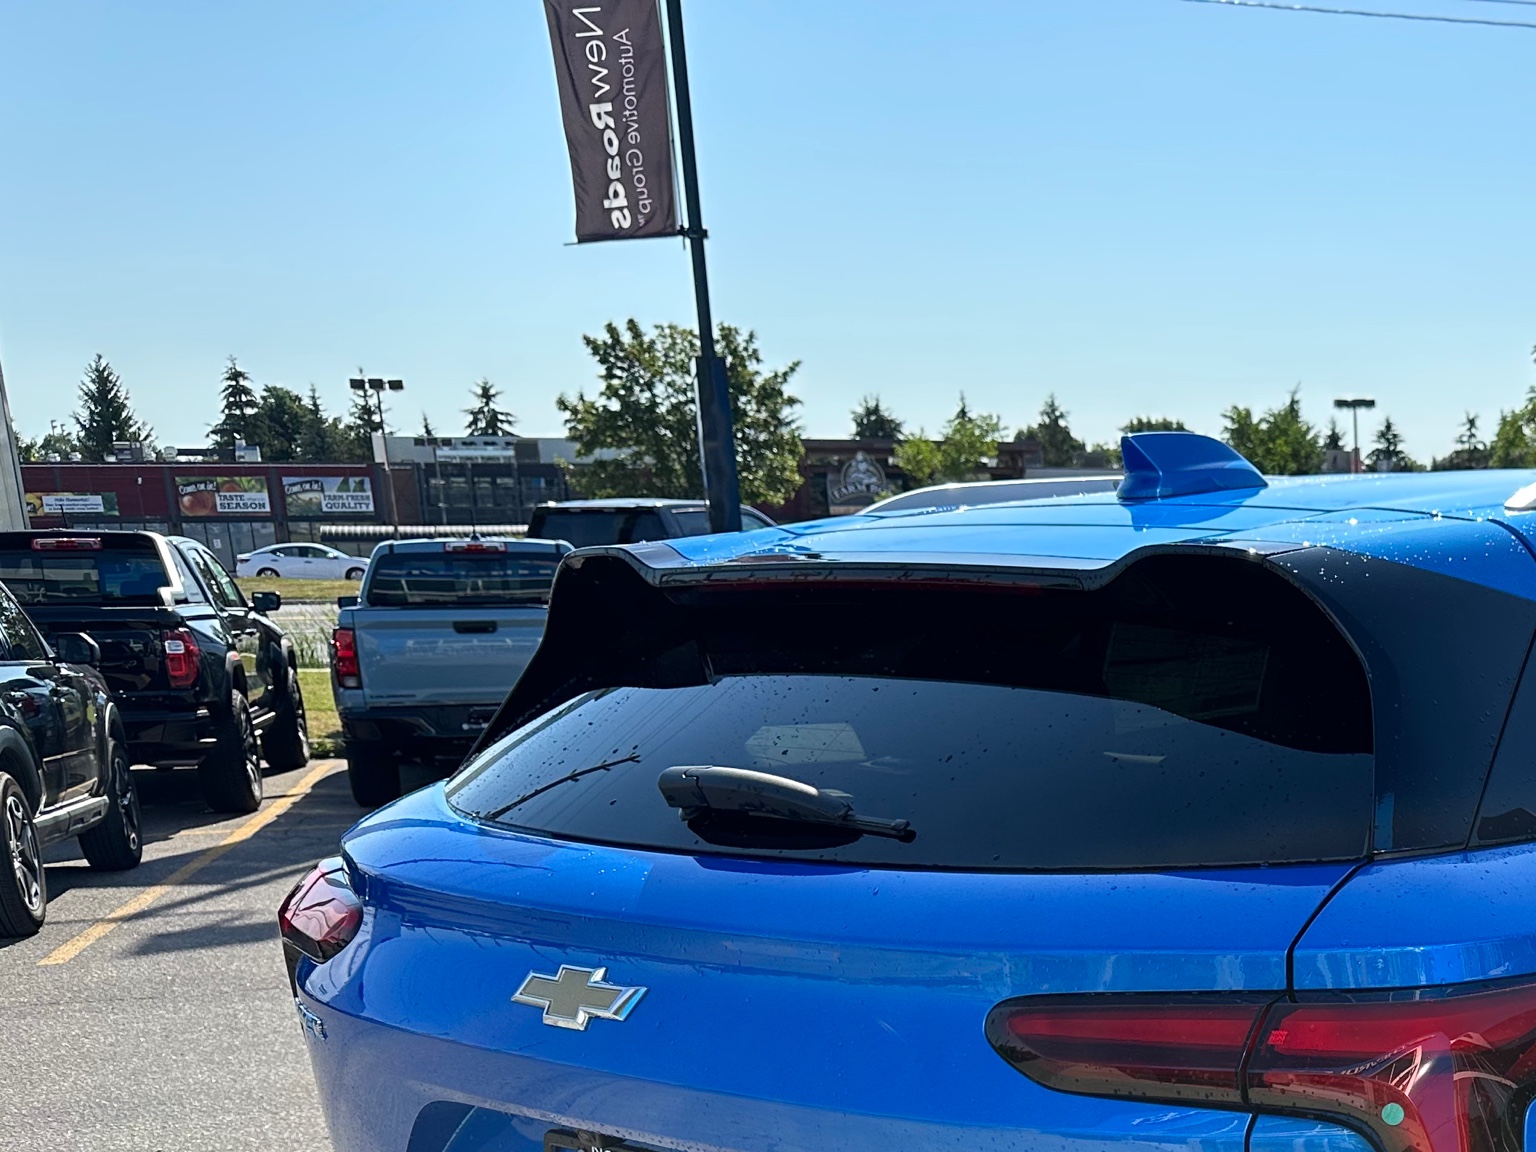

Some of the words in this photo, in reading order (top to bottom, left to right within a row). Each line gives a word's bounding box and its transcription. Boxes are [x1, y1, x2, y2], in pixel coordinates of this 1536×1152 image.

[833, 482, 867, 499] FARM
[218, 494, 245, 502] TASTE
[219, 502, 267, 510] SEASON
[325, 502, 371, 510] QUALITY
